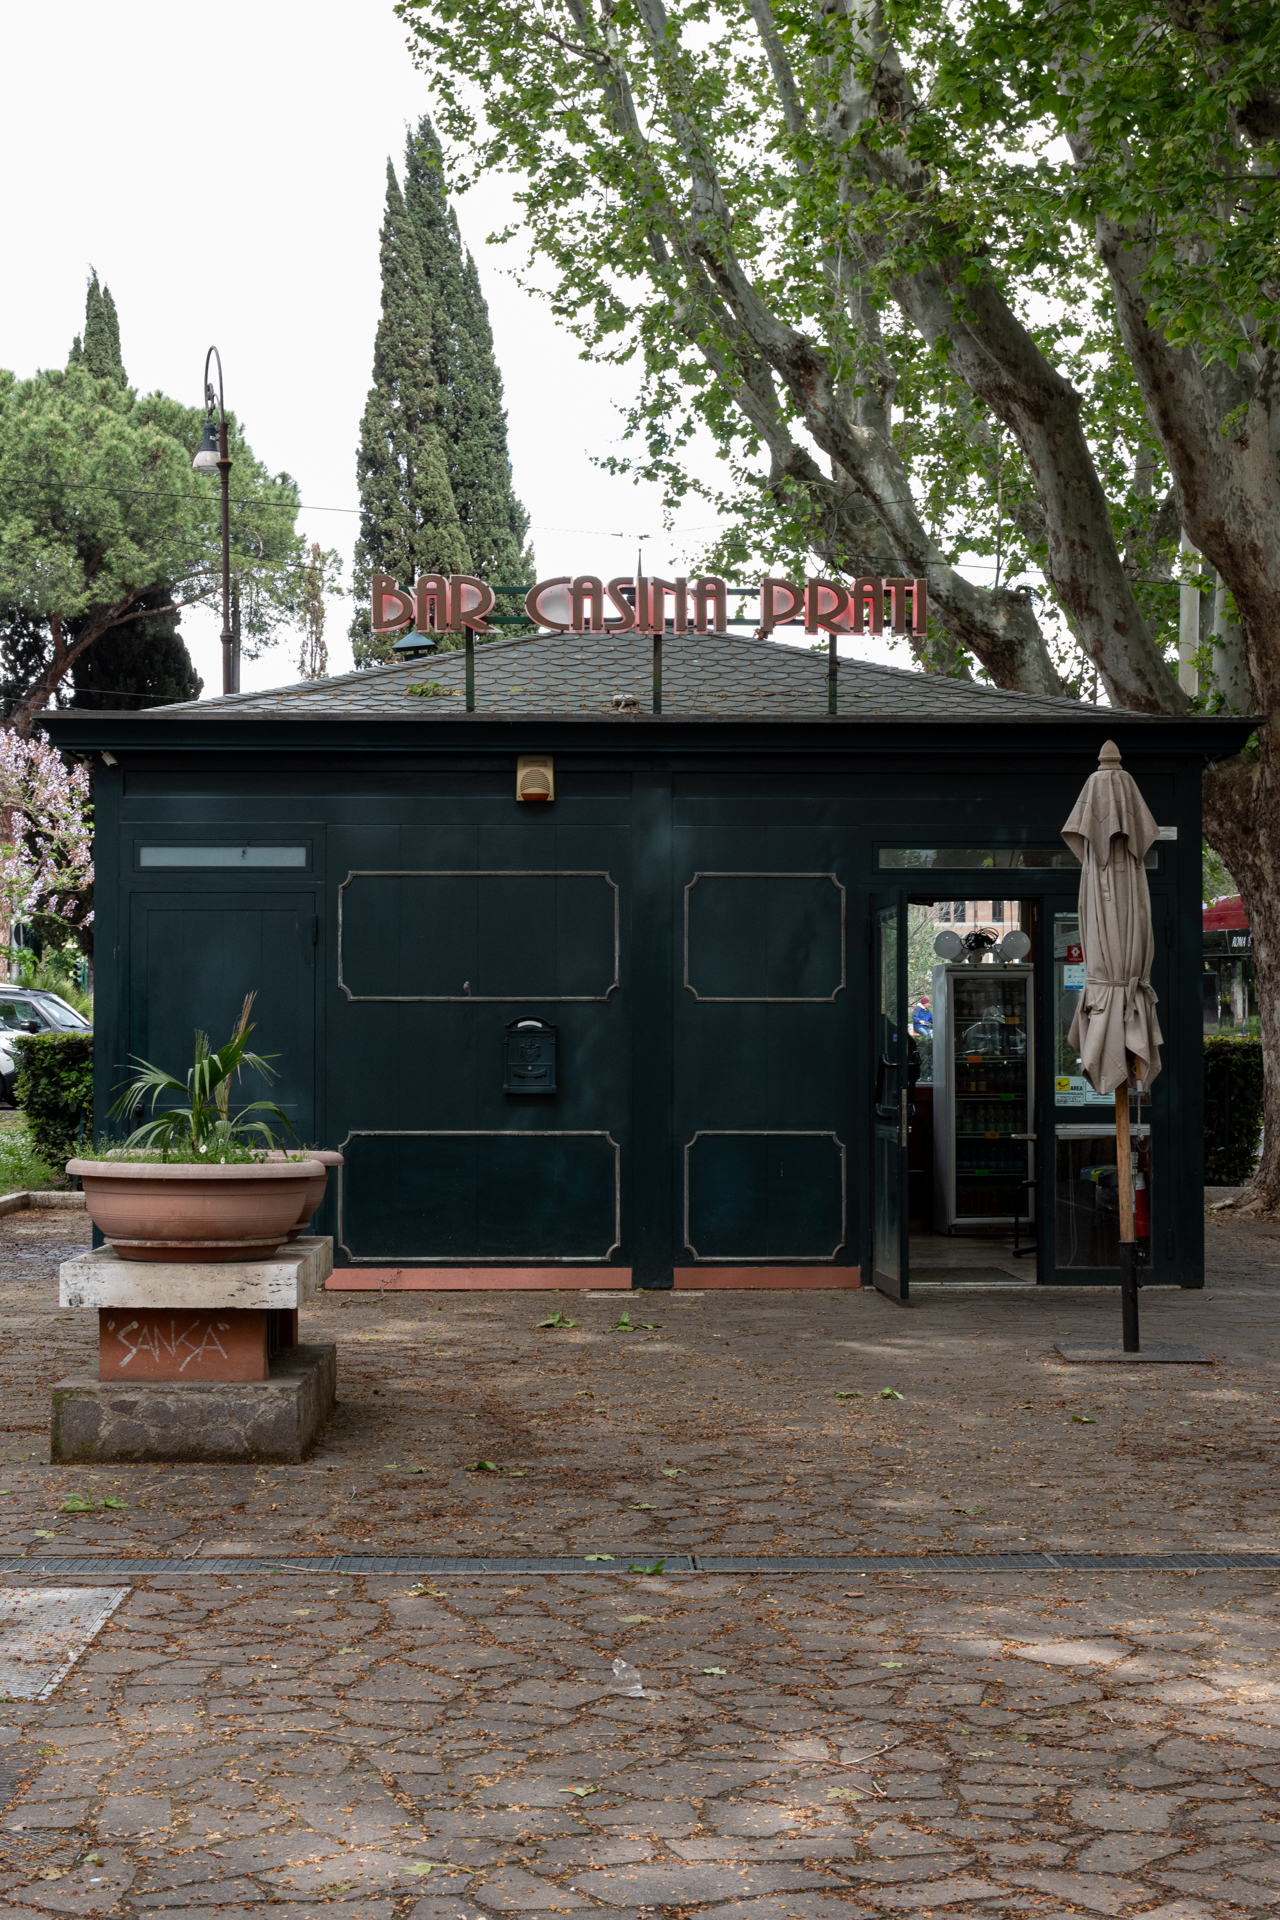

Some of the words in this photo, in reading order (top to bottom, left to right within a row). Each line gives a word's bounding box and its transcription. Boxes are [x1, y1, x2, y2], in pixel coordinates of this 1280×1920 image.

[371, 573, 503, 633] BAR
[525, 575, 727, 635] CASINA
[760, 576, 927, 637] PRATI
[1231, 936, 1246, 947] ROMA
